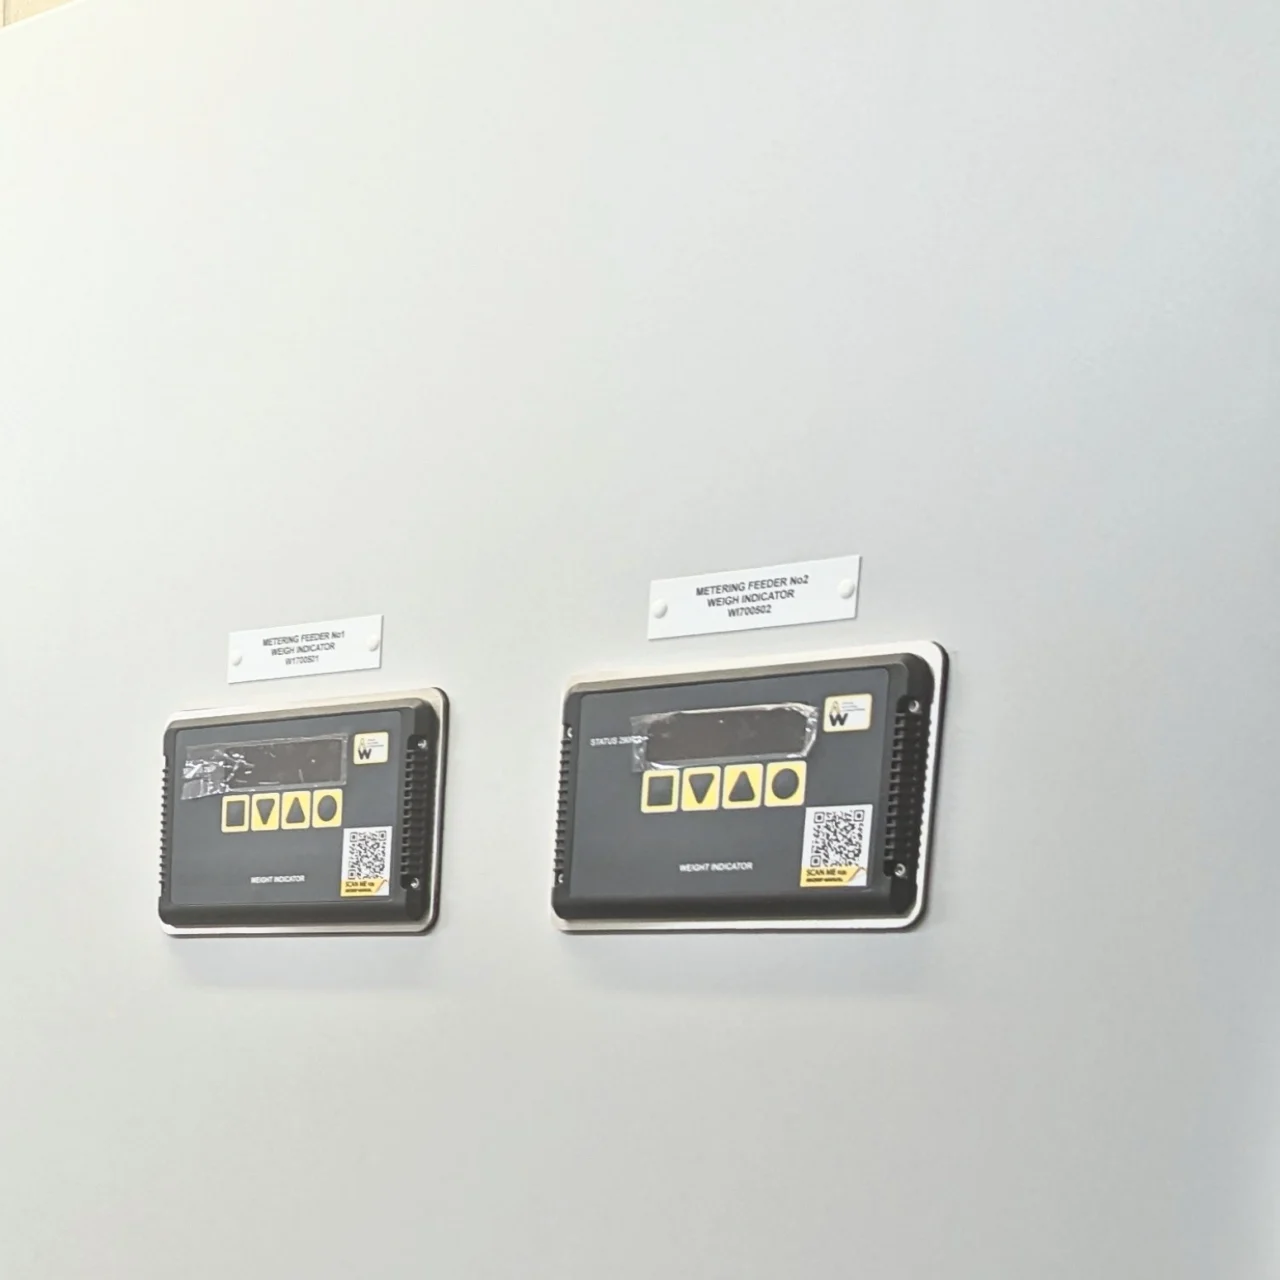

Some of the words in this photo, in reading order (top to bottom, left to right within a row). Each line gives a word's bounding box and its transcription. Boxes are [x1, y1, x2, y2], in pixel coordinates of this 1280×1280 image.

[695, 582, 745, 596] METERING
[748, 577, 787, 590] FEEDER
[789, 574, 809, 585] No2
[707, 595, 739, 607] WEIGH
[741, 589, 795, 603] INDICATOR
[262, 635, 299, 646] METERING
[301, 632, 330, 642] FEEDER
[271, 646, 295, 656] WEIGH
[296, 642, 336, 653] INDICATOR
[590, 737, 617, 747] STATUS
[679, 863, 709, 872] WEIGHT
[711, 861, 753, 871] INDICATOR
[251, 876, 273, 884] WEIGHT
[274, 874, 305, 882] INDICATOR
